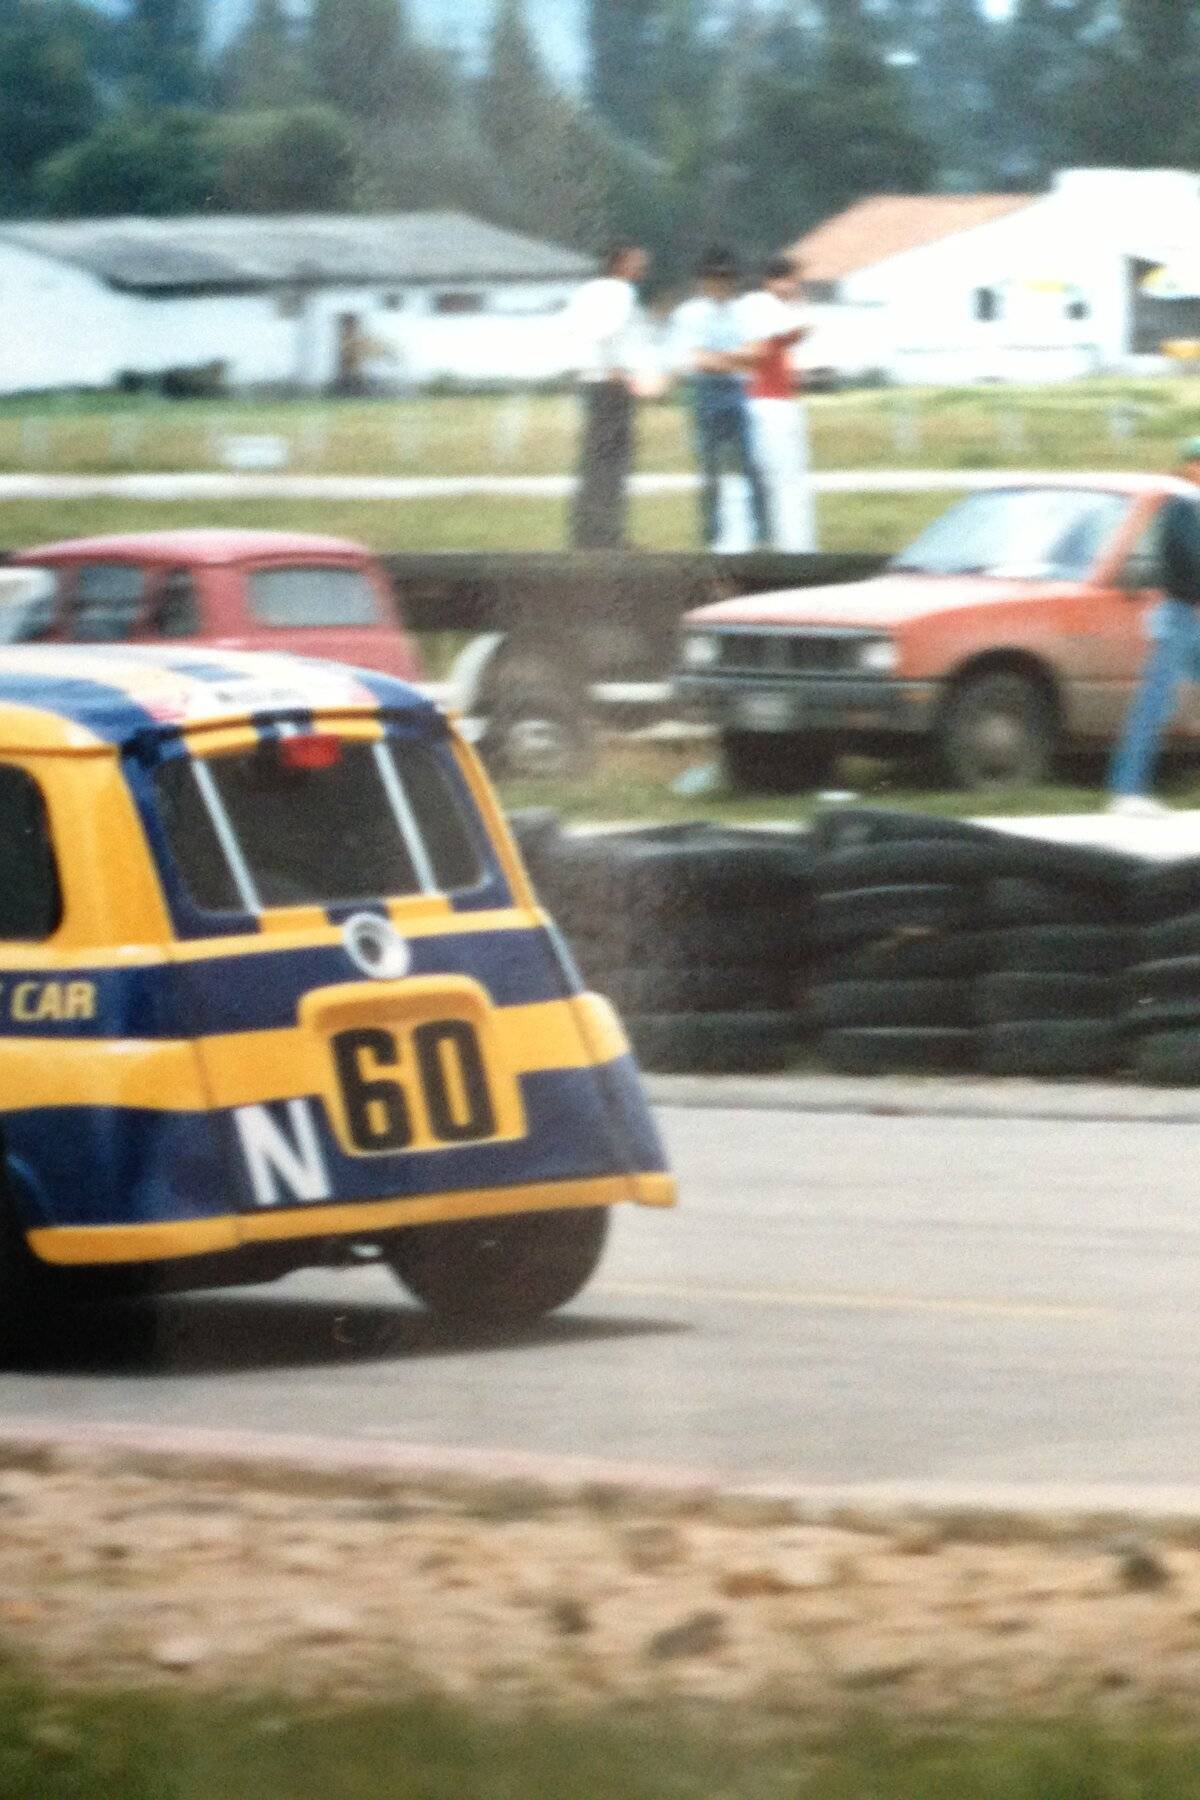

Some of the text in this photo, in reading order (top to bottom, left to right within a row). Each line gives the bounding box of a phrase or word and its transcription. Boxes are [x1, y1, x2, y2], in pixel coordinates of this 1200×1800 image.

[10, 980, 98, 1021] CAR
[330, 1018, 498, 1152] 60
[234, 1099, 331, 1206] N
